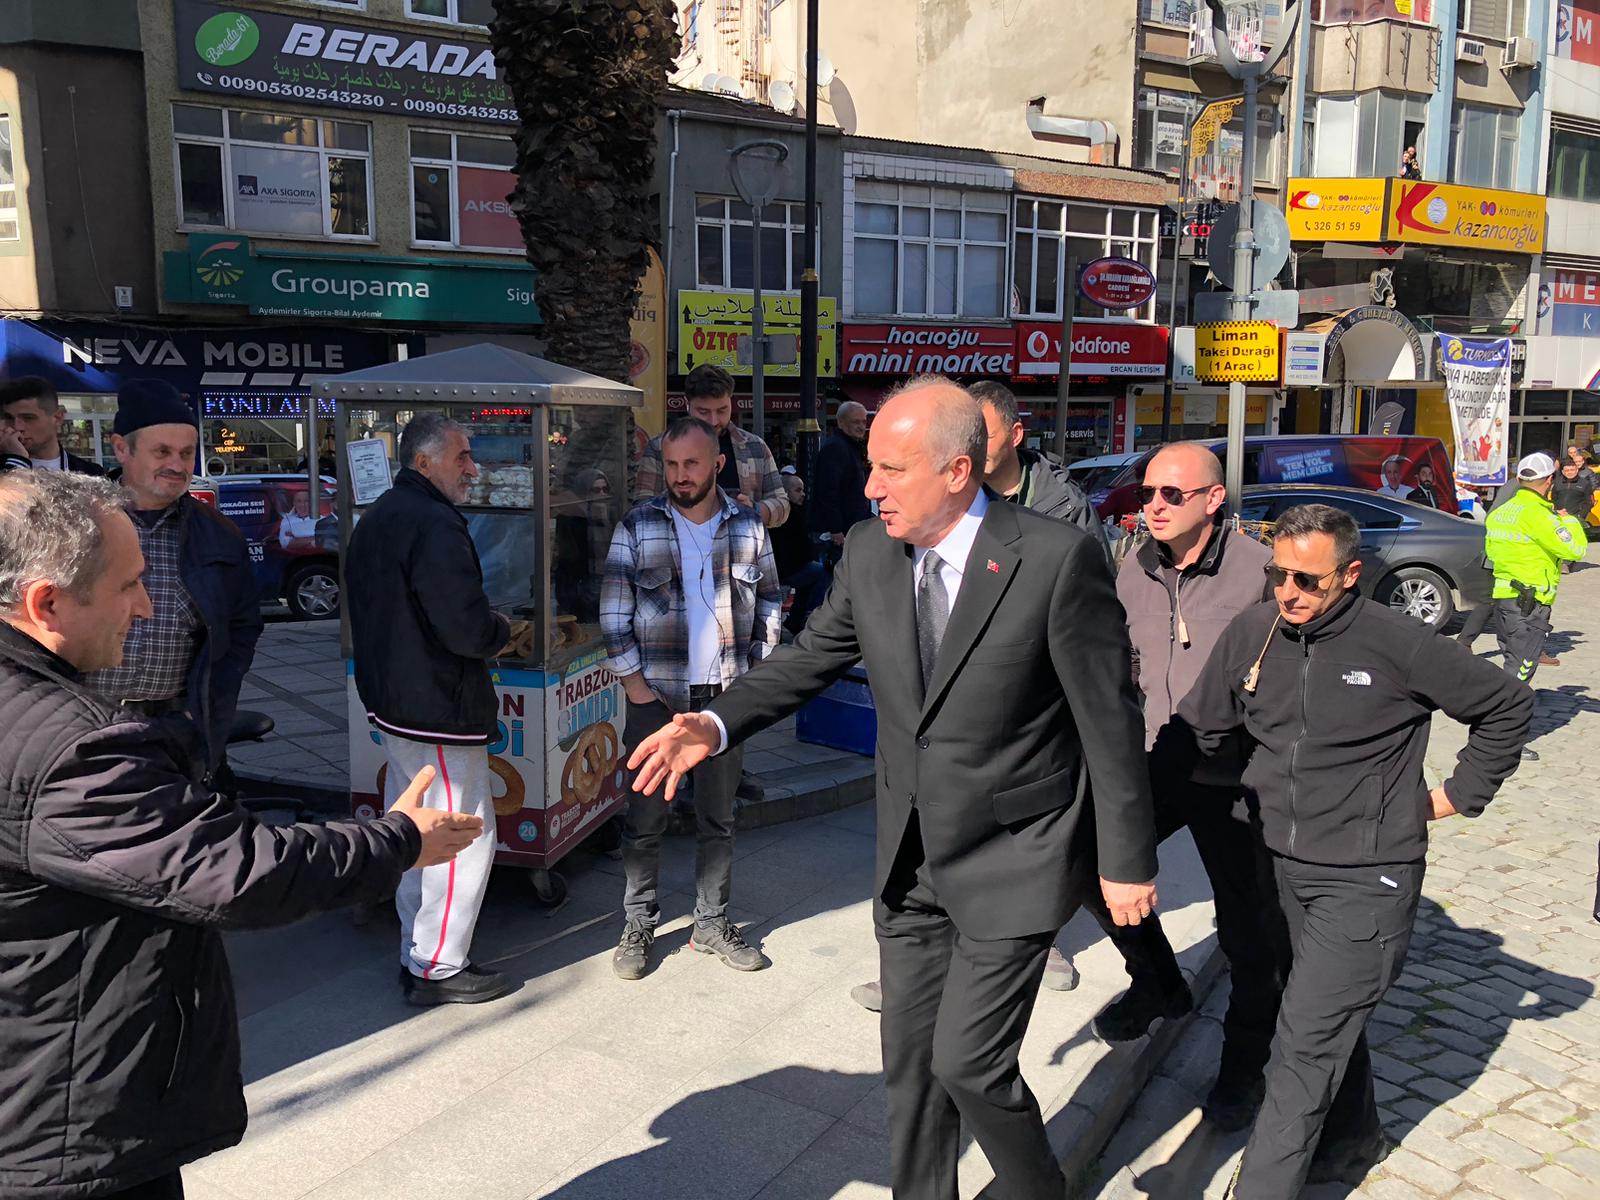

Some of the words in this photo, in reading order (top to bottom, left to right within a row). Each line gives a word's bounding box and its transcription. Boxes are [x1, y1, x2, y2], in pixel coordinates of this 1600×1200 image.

[280, 22, 497, 80] BERADA
[219, 75, 385, 107] 00905302543230
[260, 187, 278, 196] AXA
[280, 187, 316, 198] SİGORTA
[1314, 221, 1331, 231] 326
[1335, 221, 1346, 231] 51
[1349, 221, 1361, 231] 59
[271, 268, 431, 301] Groupama
[258, 306, 301, 317] Aydemirler
[351, 310, 383, 318] Aydemir
[887, 326, 980, 350] hacıoğlu
[1212, 330, 1258, 342] Liman
[1053, 335, 1131, 355] vdafone
[1198, 346, 1230, 357] Taksi
[1232, 346, 1275, 358] Durağı
[62, 336, 188, 367] NEVA
[203, 341, 345, 369] MOBILE
[848, 347, 914, 373] mini
[915, 351, 1015, 375] market
[1133, 366, 1161, 374] İLETİŞİM
[1070, 428, 1095, 438] SERVİS
[1283, 460, 1305, 471] TEK
[1304, 457, 1325, 467] YOL
[1281, 462, 1335, 482] MEMLEKET
[519, 824, 536, 838] 20
